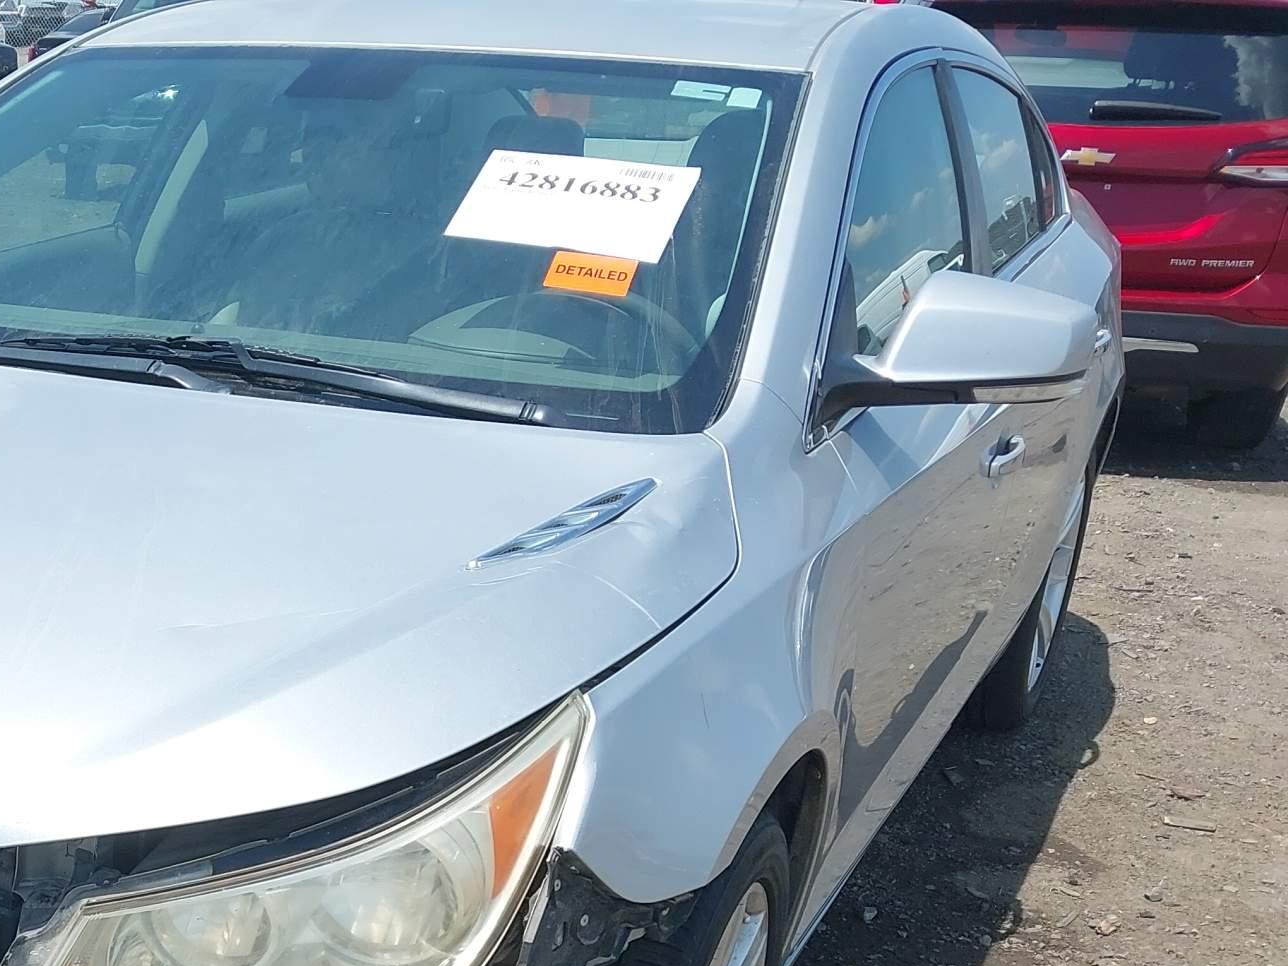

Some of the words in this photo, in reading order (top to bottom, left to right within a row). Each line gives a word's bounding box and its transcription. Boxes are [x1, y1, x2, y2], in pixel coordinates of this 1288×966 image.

[499, 171, 661, 203] 42816883
[555, 263, 628, 282] DETAILED
[1201, 259, 1255, 268] PREMIER
